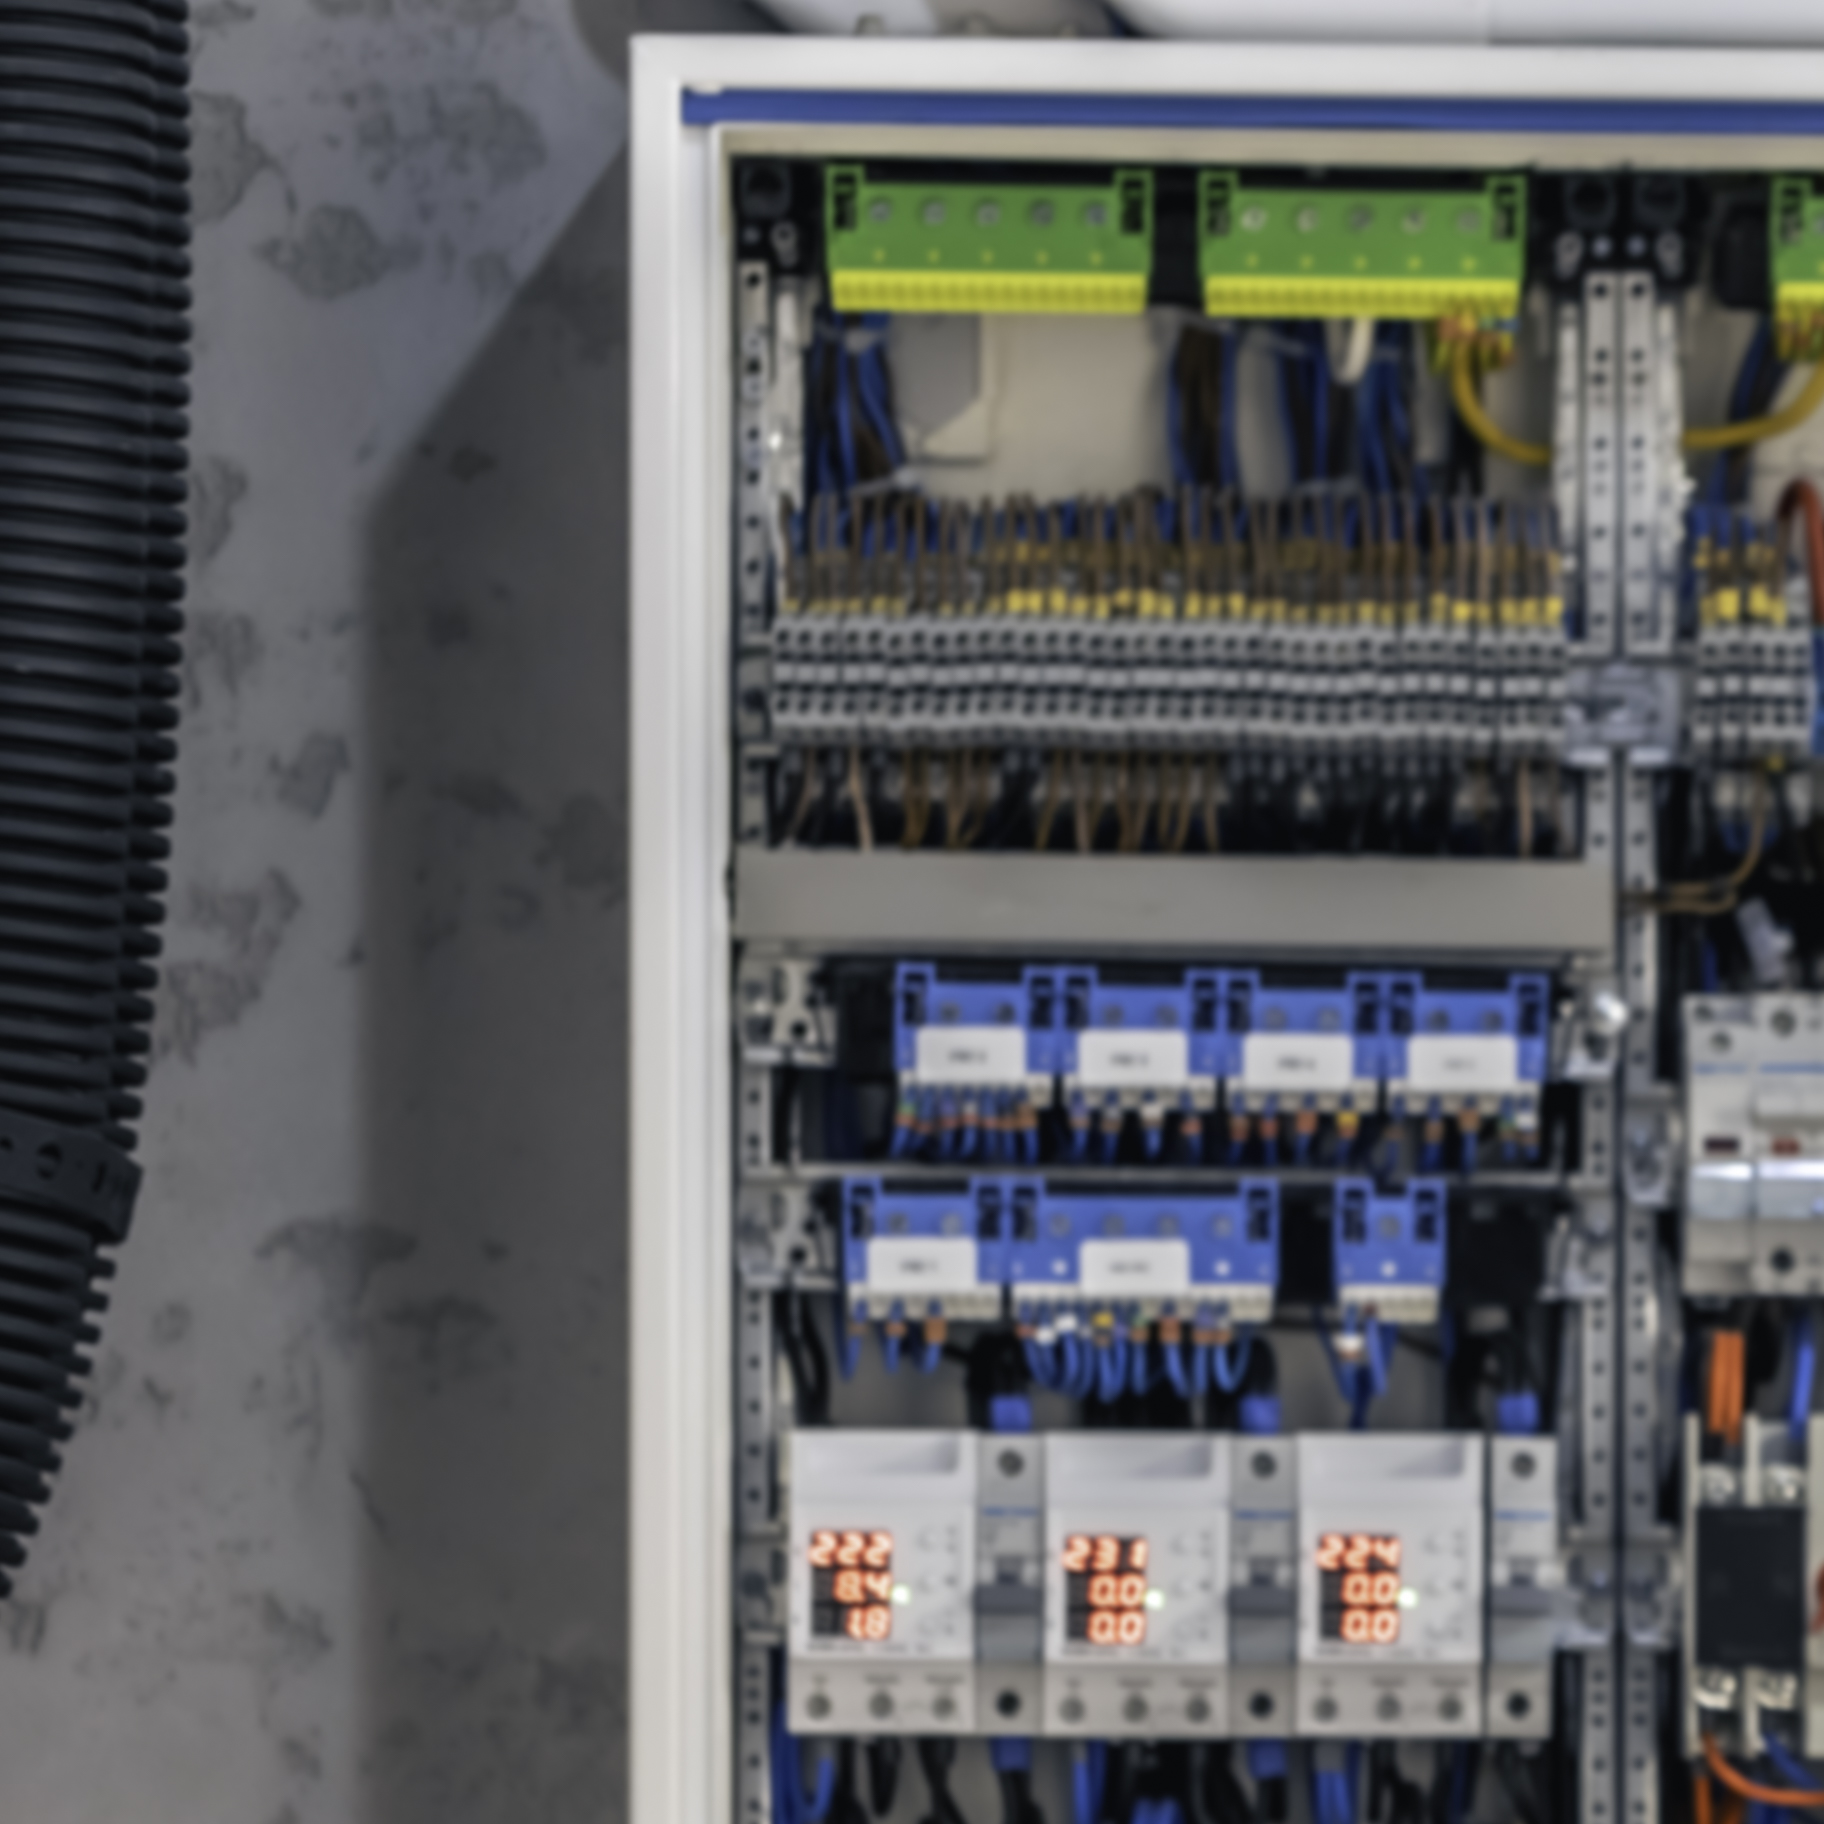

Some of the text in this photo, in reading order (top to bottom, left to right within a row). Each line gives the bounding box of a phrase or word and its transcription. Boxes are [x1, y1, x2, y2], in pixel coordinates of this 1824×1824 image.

[810, 1531, 892, 1568] 222
[1062, 1535, 1147, 1573] 231
[1317, 1534, 1399, 1571] 224
